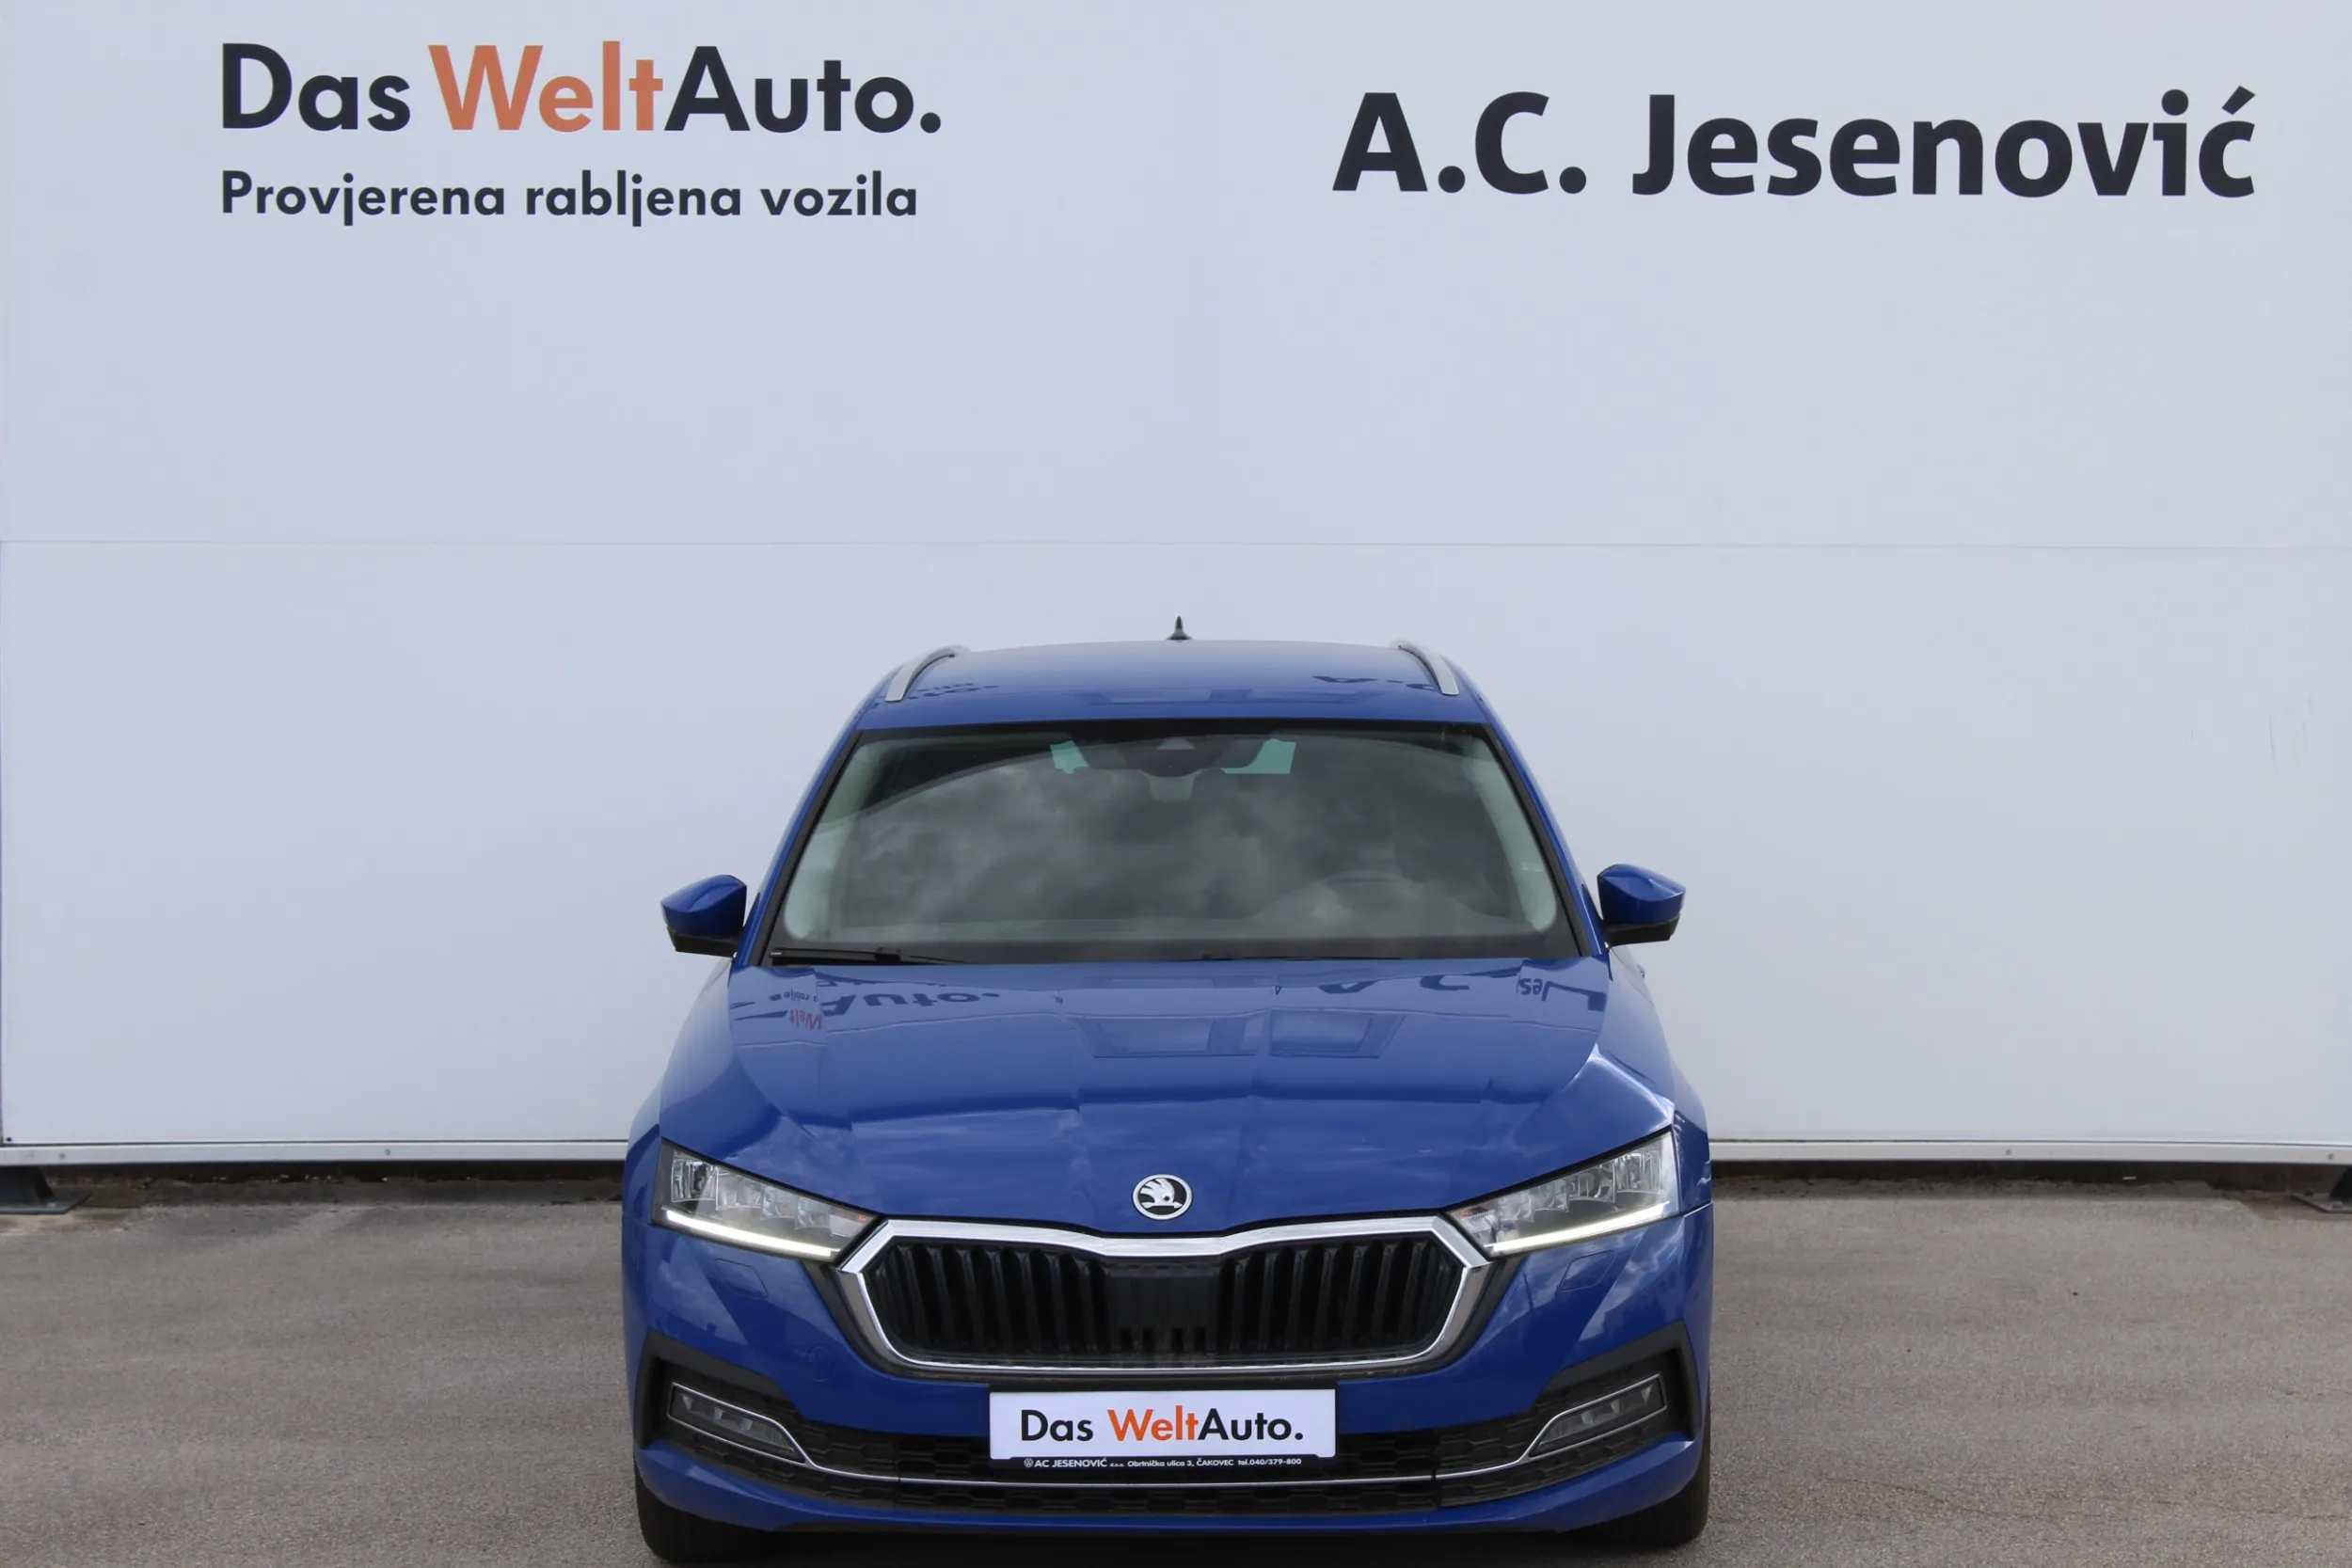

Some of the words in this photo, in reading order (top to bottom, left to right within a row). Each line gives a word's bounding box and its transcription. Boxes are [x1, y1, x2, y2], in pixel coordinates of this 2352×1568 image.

[222, 42, 411, 132] Das
[428, 40, 942, 134] WeltAuto.
[1332, 91, 1587, 195] A.C.
[1632, 86, 2256, 198] Jesenović
[222, 169, 505, 227] Provjerena
[526, 169, 741, 228] rabljena
[759, 169, 917, 217] vozila
[1021, 1409, 1094, 1442] Das
[1107, 1405, 1304, 1442] WeltAuto.
[1034, 1459, 1050, 1467] AC
[1052, 1457, 1108, 1467] JESENOVIĆ
[1196, 1457, 1234, 1466] ČAKOVEC
